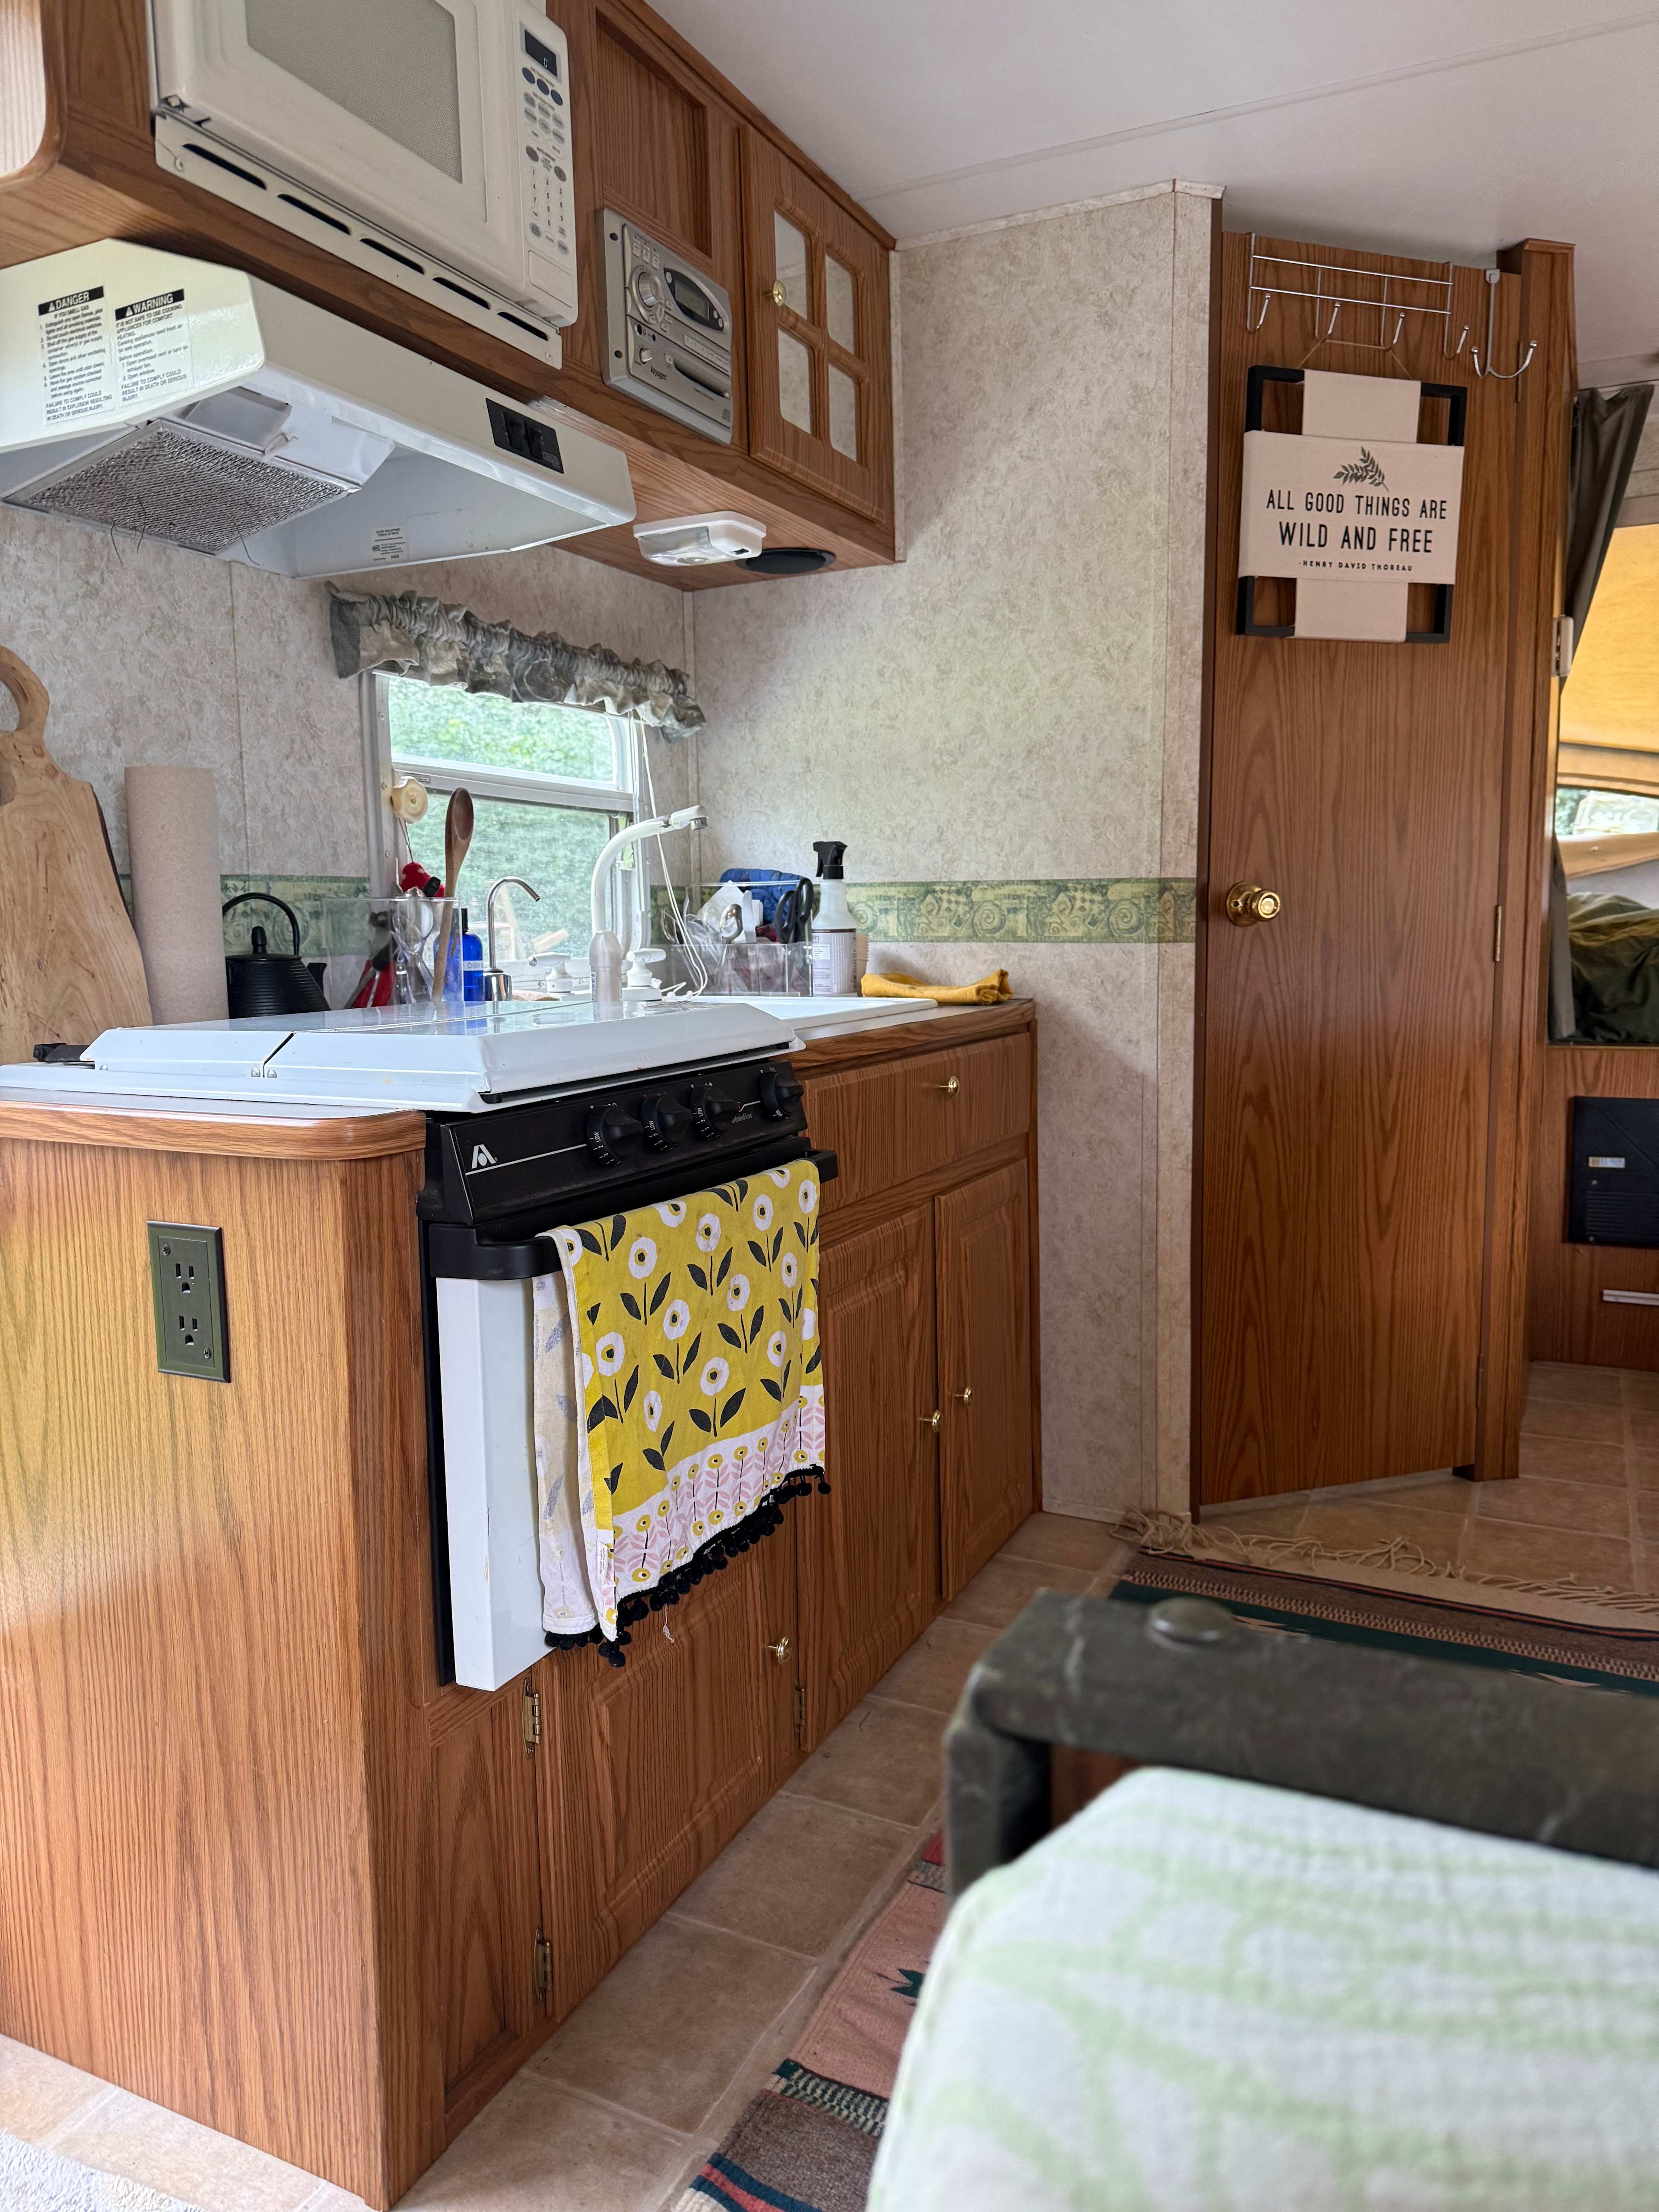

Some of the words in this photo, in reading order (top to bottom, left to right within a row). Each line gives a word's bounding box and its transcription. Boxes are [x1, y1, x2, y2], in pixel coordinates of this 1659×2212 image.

[56, 292, 90, 310] DANGER
[133, 293, 174, 314] WARNING
[1266, 489, 1294, 510] ALL
[1305, 492, 1344, 513] GOOD
[1355, 495, 1410, 517] THINGS
[1419, 499, 1447, 519] ARE
[1279, 521, 1328, 547] WILD
[1341, 525, 1376, 550] AND
[1389, 528, 1433, 553] FREE
